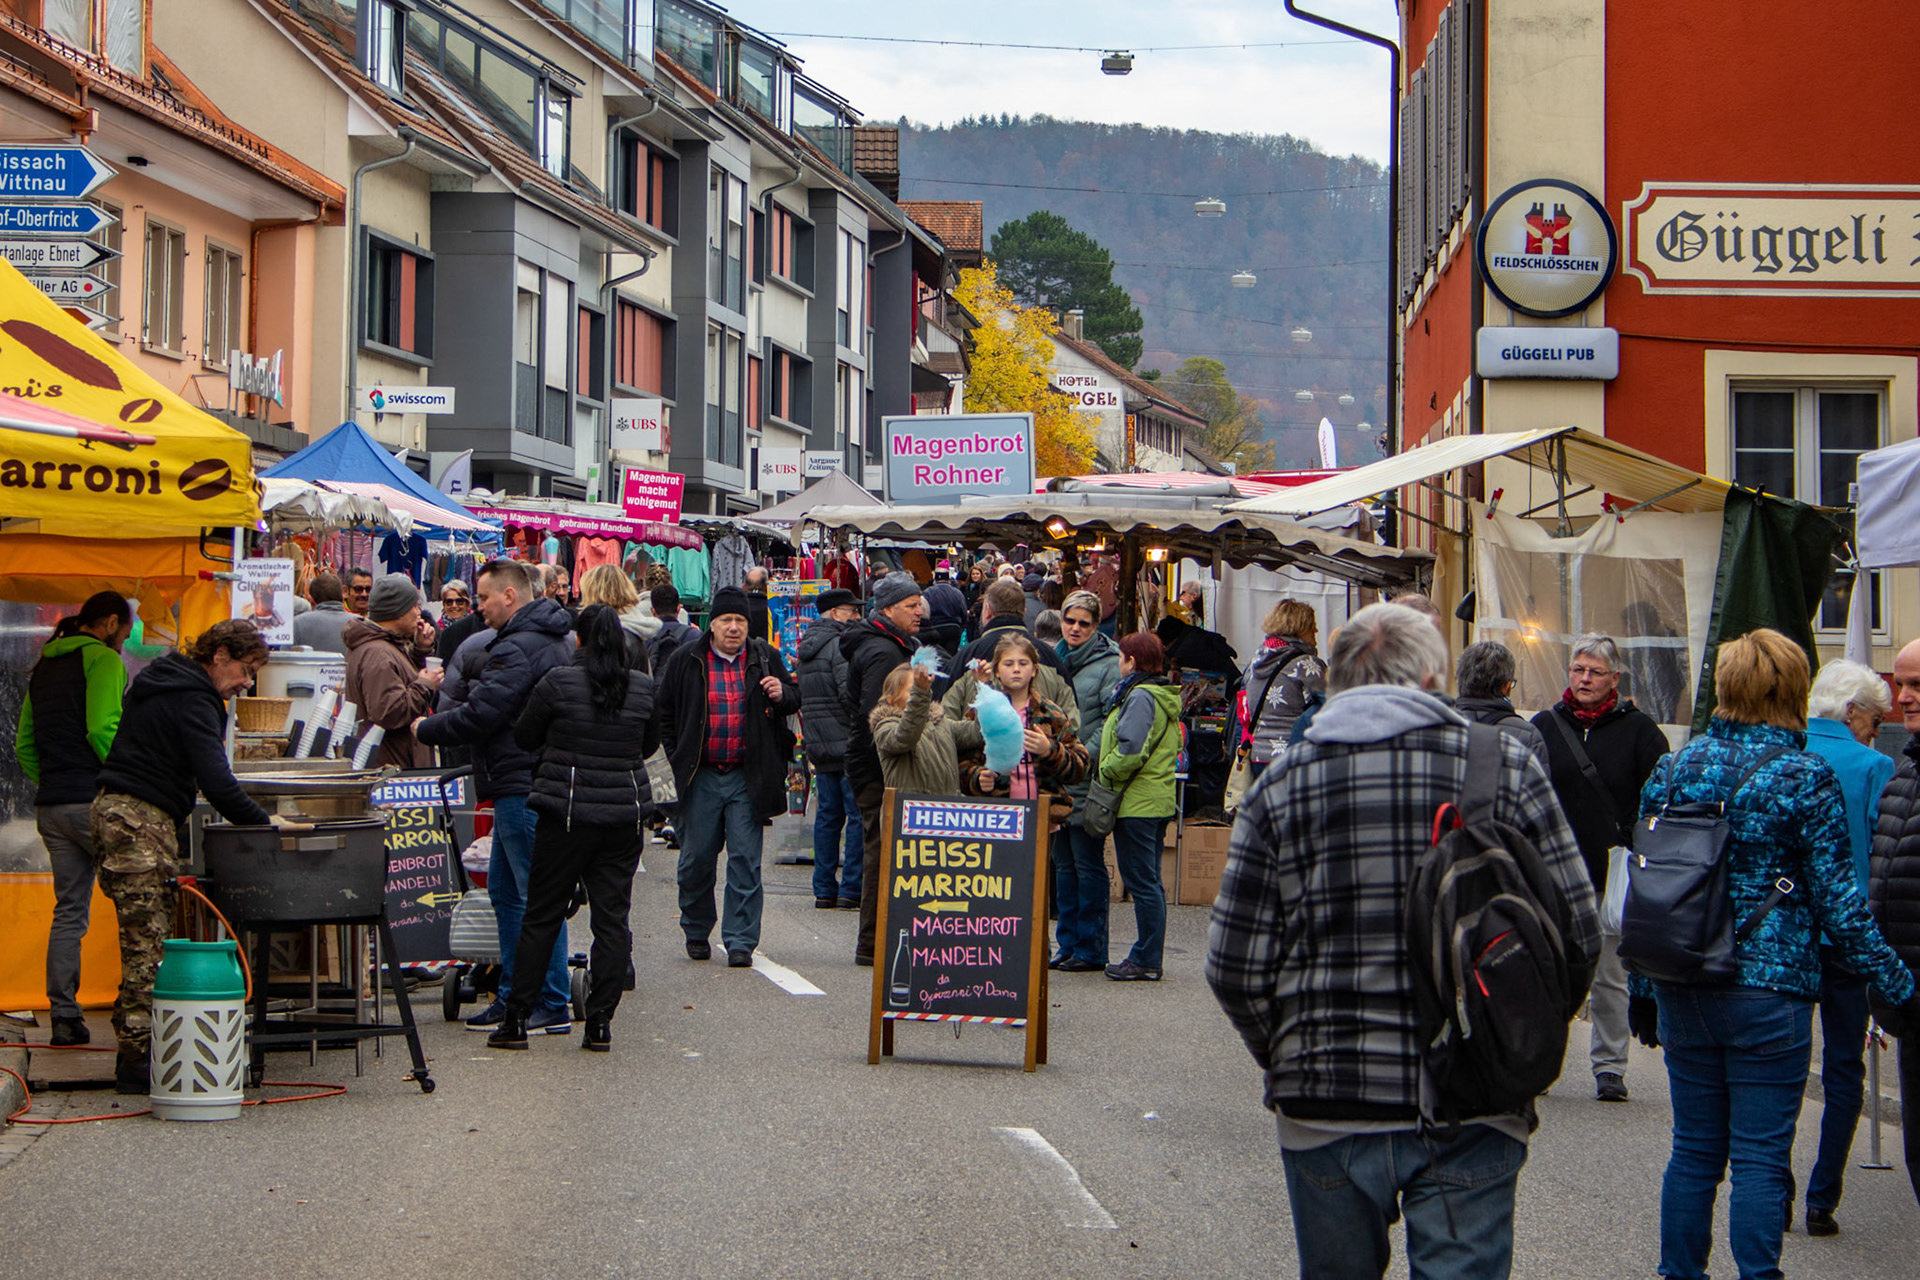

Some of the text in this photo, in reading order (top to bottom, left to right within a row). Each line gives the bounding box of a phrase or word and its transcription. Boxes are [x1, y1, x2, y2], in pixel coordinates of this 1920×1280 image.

[0, 153, 66, 170] issach
[1656, 210, 1888, 275] Güggeli
[50, 245, 80, 261] Ebnet
[1494, 256, 1599, 272] FELDSCHLÖSSCHEN
[61, 280, 78, 293] AG
[1501, 345, 1596, 361] GÜGGELI PUB
[1058, 376, 1097, 387] HOTEL
[388, 392, 446, 405] swisscom
[631, 418, 657, 430] UBS
[893, 432, 1024, 460] Magenbrot
[775, 464, 797, 474] UBS
[914, 464, 1004, 486] Rohner
[0, 460, 162, 495] arroni
[629, 471, 680, 485] Magenbrot
[638, 485, 668, 496] macht
[626, 496, 677, 510] wohlgemut
[509, 513, 551, 525] Magenbrot
[559, 519, 634, 533] gebrannte Mandeln
[237, 581, 291, 592] Glühwein
[915, 810, 1011, 829] HENNIEZ
[896, 839, 992, 870] HEISSI
[388, 854, 445, 873] ENBROT
[385, 875, 442, 893] ANDELN
[893, 873, 1012, 900] MARRONI
[913, 916, 1022, 937] MAGENBROT
[913, 946, 1003, 967] MANDELN
[937, 974, 950, 985] da
